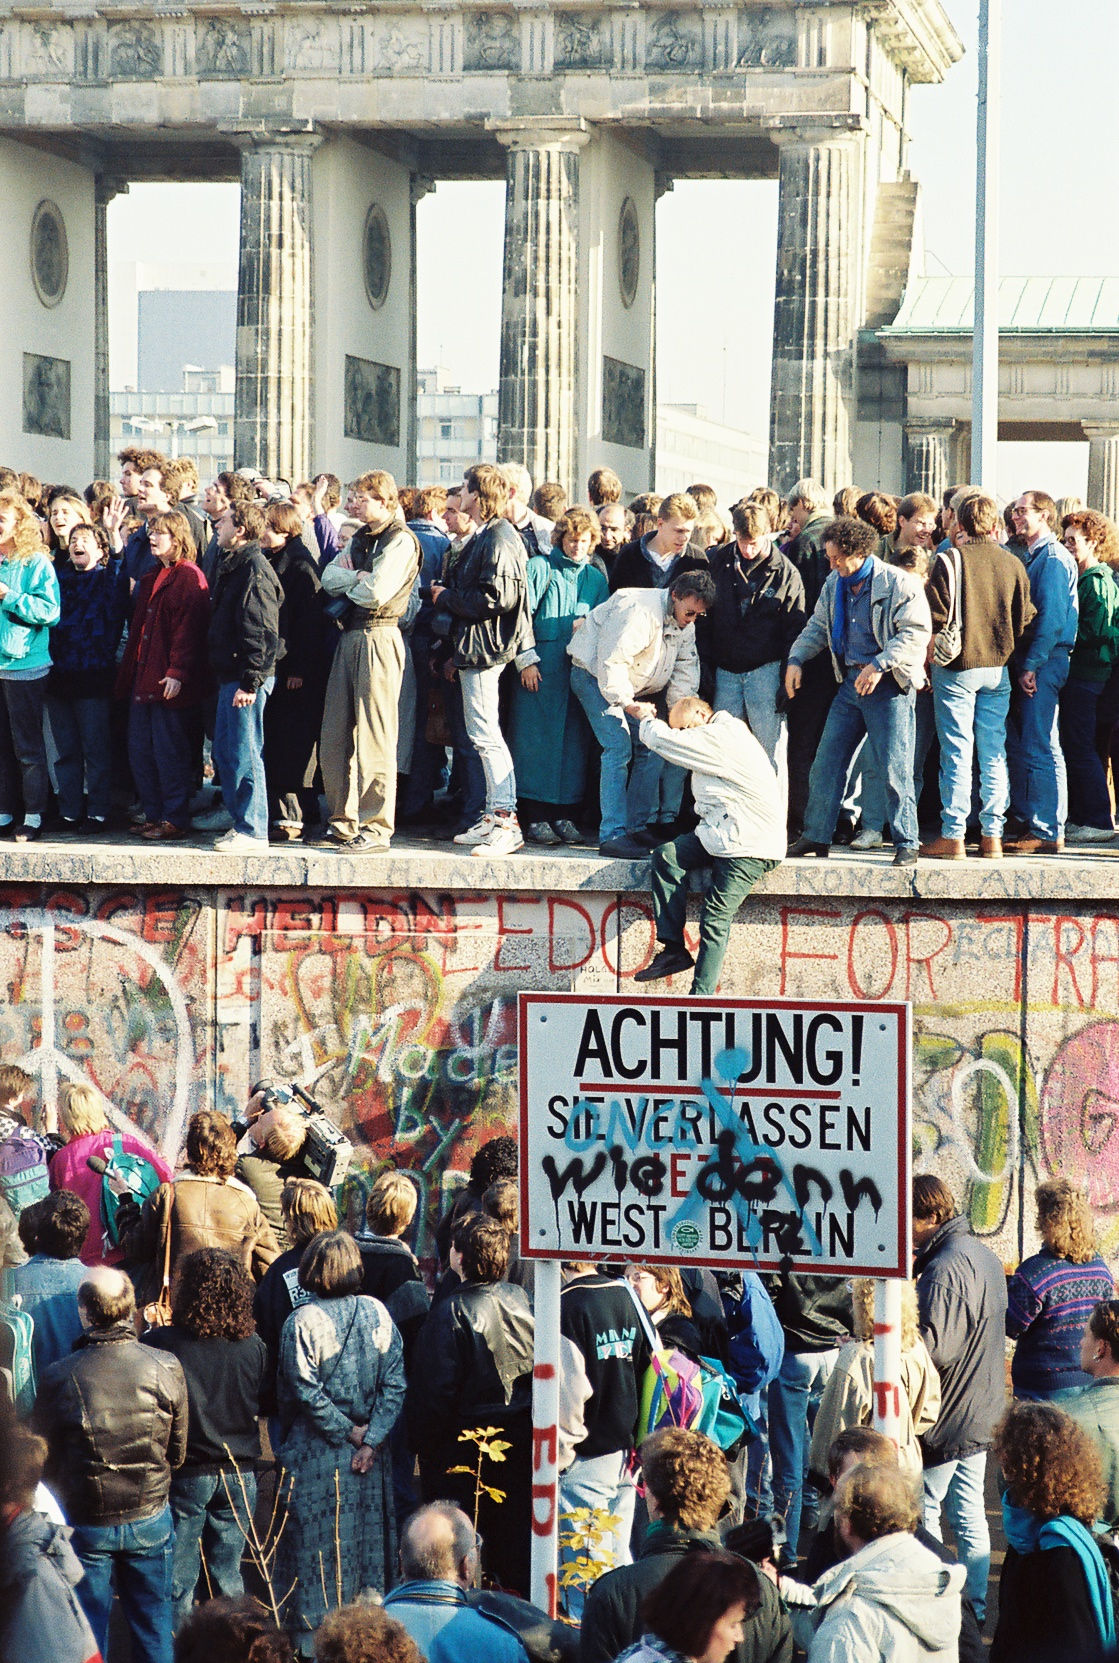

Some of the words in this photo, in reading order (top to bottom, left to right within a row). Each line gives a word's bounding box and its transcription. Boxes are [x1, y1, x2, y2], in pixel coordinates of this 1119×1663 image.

[779, 906, 952, 1000] FOR
[573, 1007, 864, 1087] ACHTUNG!
[547, 1095, 606, 1140] SIE
[624, 1097, 871, 1152] VERLASSEN
[568, 1201, 667, 1249] WEST
